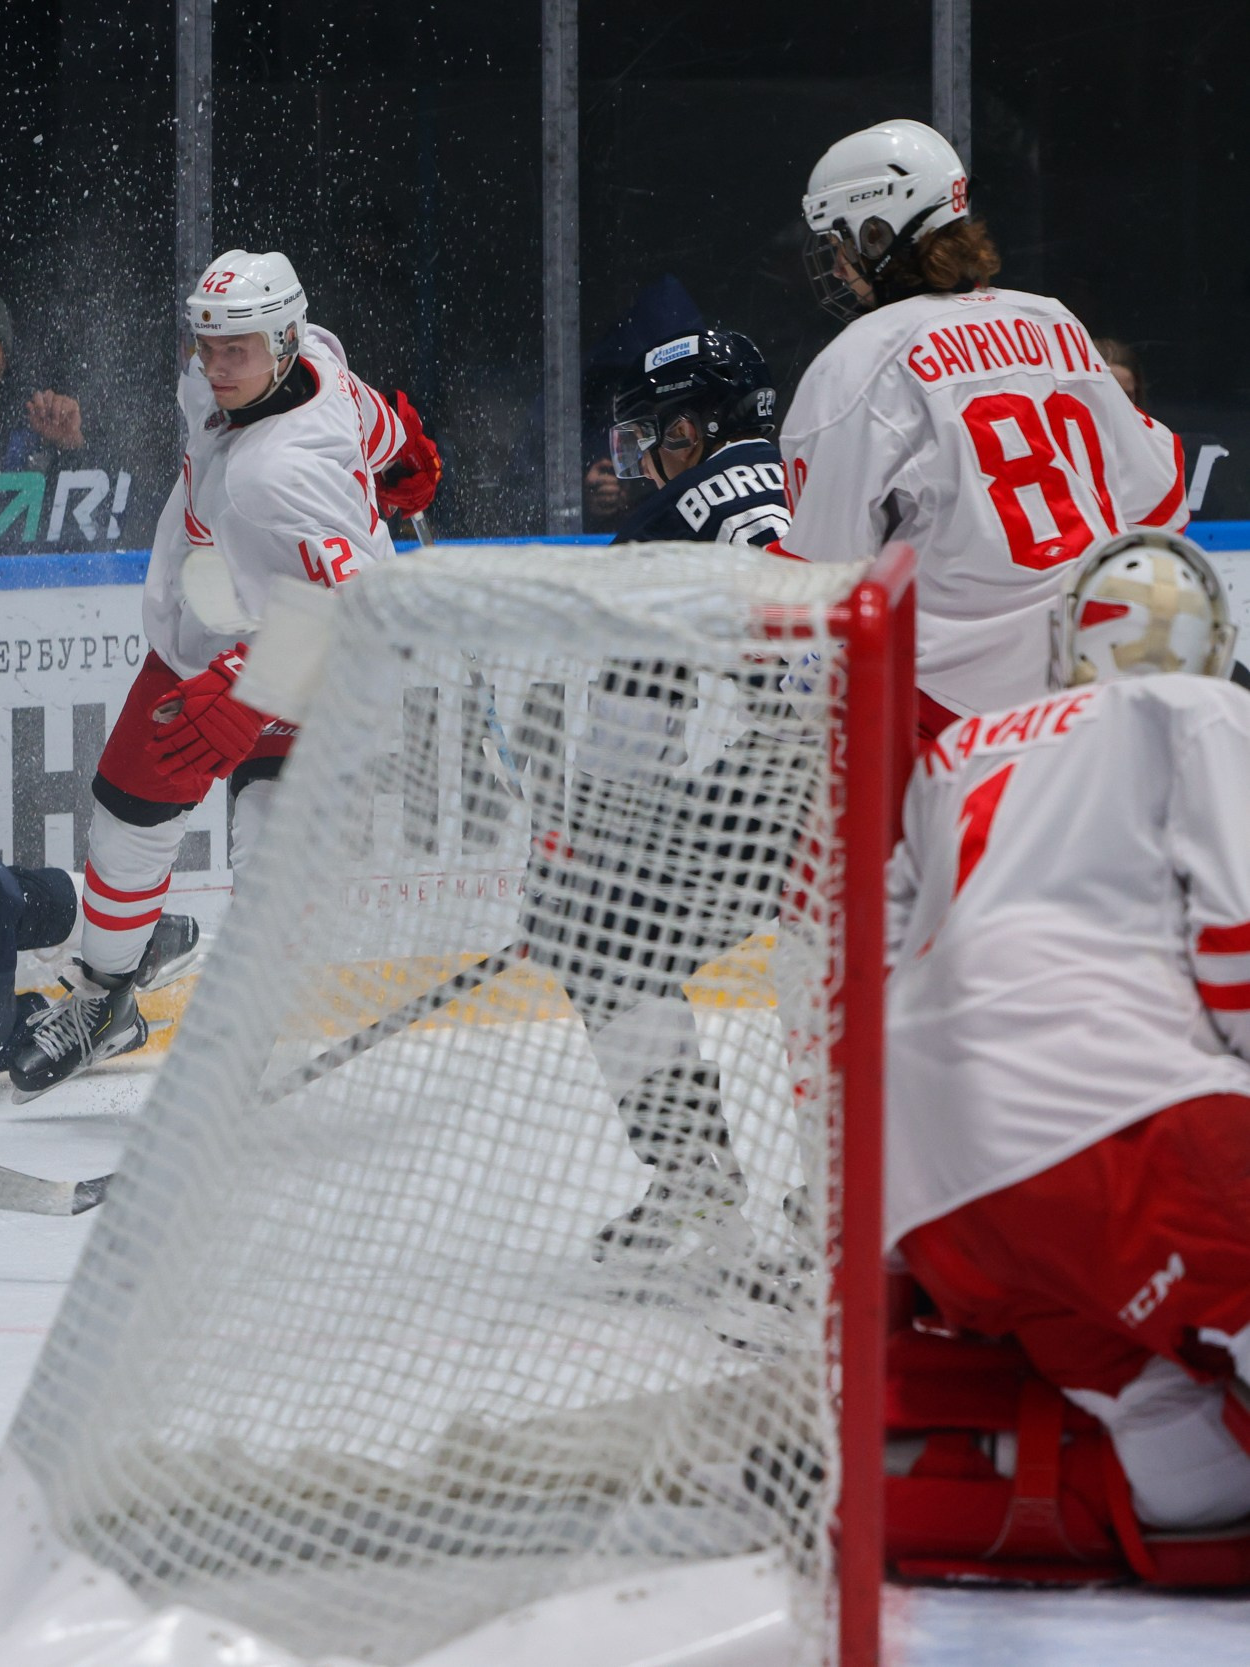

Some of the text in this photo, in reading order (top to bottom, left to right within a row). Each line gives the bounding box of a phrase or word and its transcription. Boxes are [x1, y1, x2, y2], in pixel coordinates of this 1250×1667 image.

[850, 188, 884, 203] CCM
[202, 271, 236, 294] 42
[908, 318, 1053, 383] GAVRILOV
[757, 390, 773, 417] 22
[676, 462, 785, 533] BORO
[961, 391, 1122, 572] 80
[297, 536, 359, 589] 42
